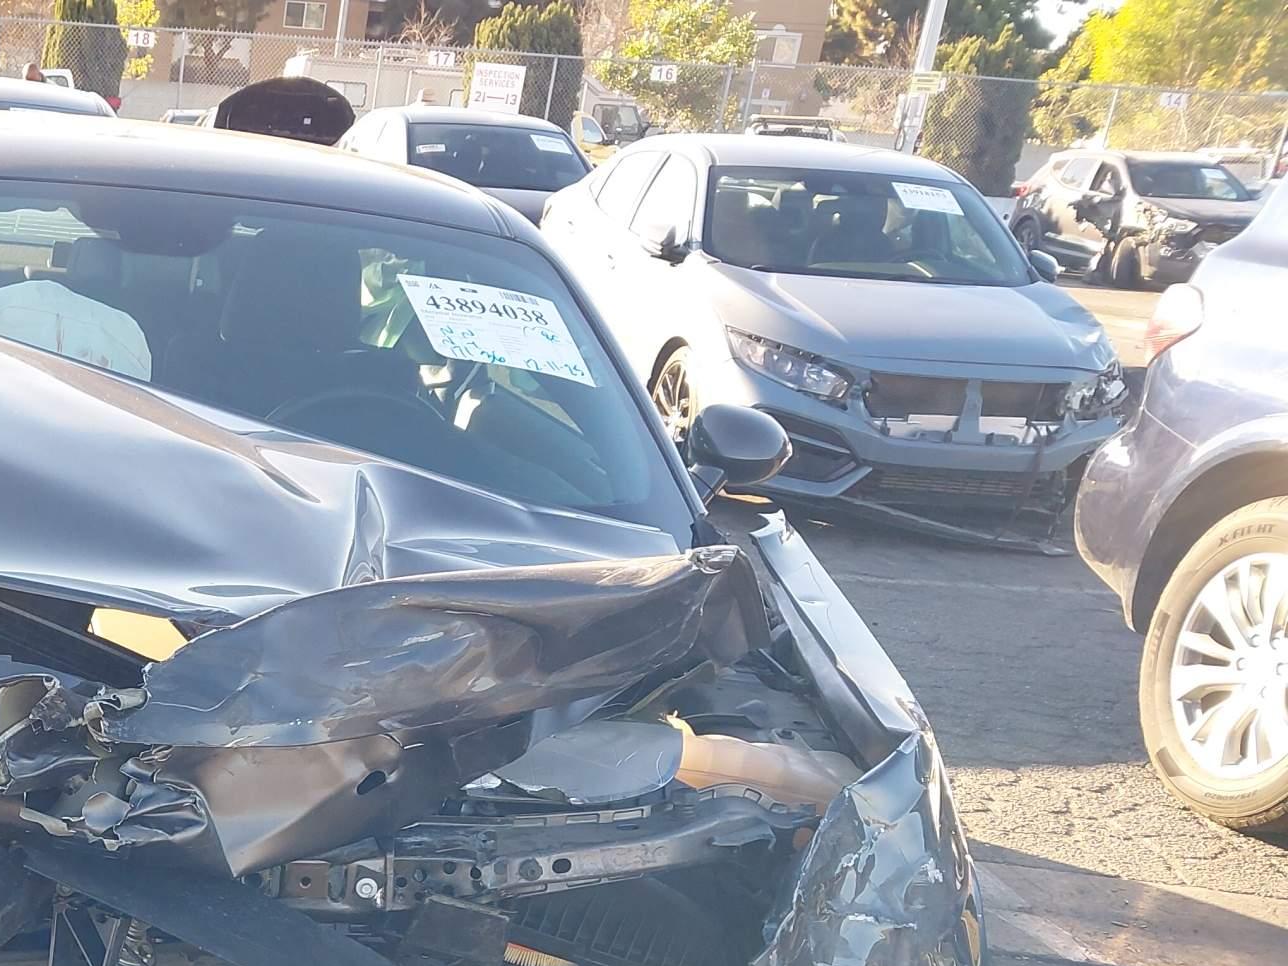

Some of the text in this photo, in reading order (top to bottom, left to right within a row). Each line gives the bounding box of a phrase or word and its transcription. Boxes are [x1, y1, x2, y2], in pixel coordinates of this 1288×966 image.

[134, 32, 150, 45] 18
[434, 52, 451, 65] 17
[476, 68, 520, 80] INSPECTION
[657, 67, 674, 80] 16
[479, 78, 516, 88] SERVICES
[1167, 94, 1182, 106] 14
[426, 295, 549, 326] 43894038
[1233, 525, 1254, 539] FIT
[1257, 523, 1276, 534] HT
